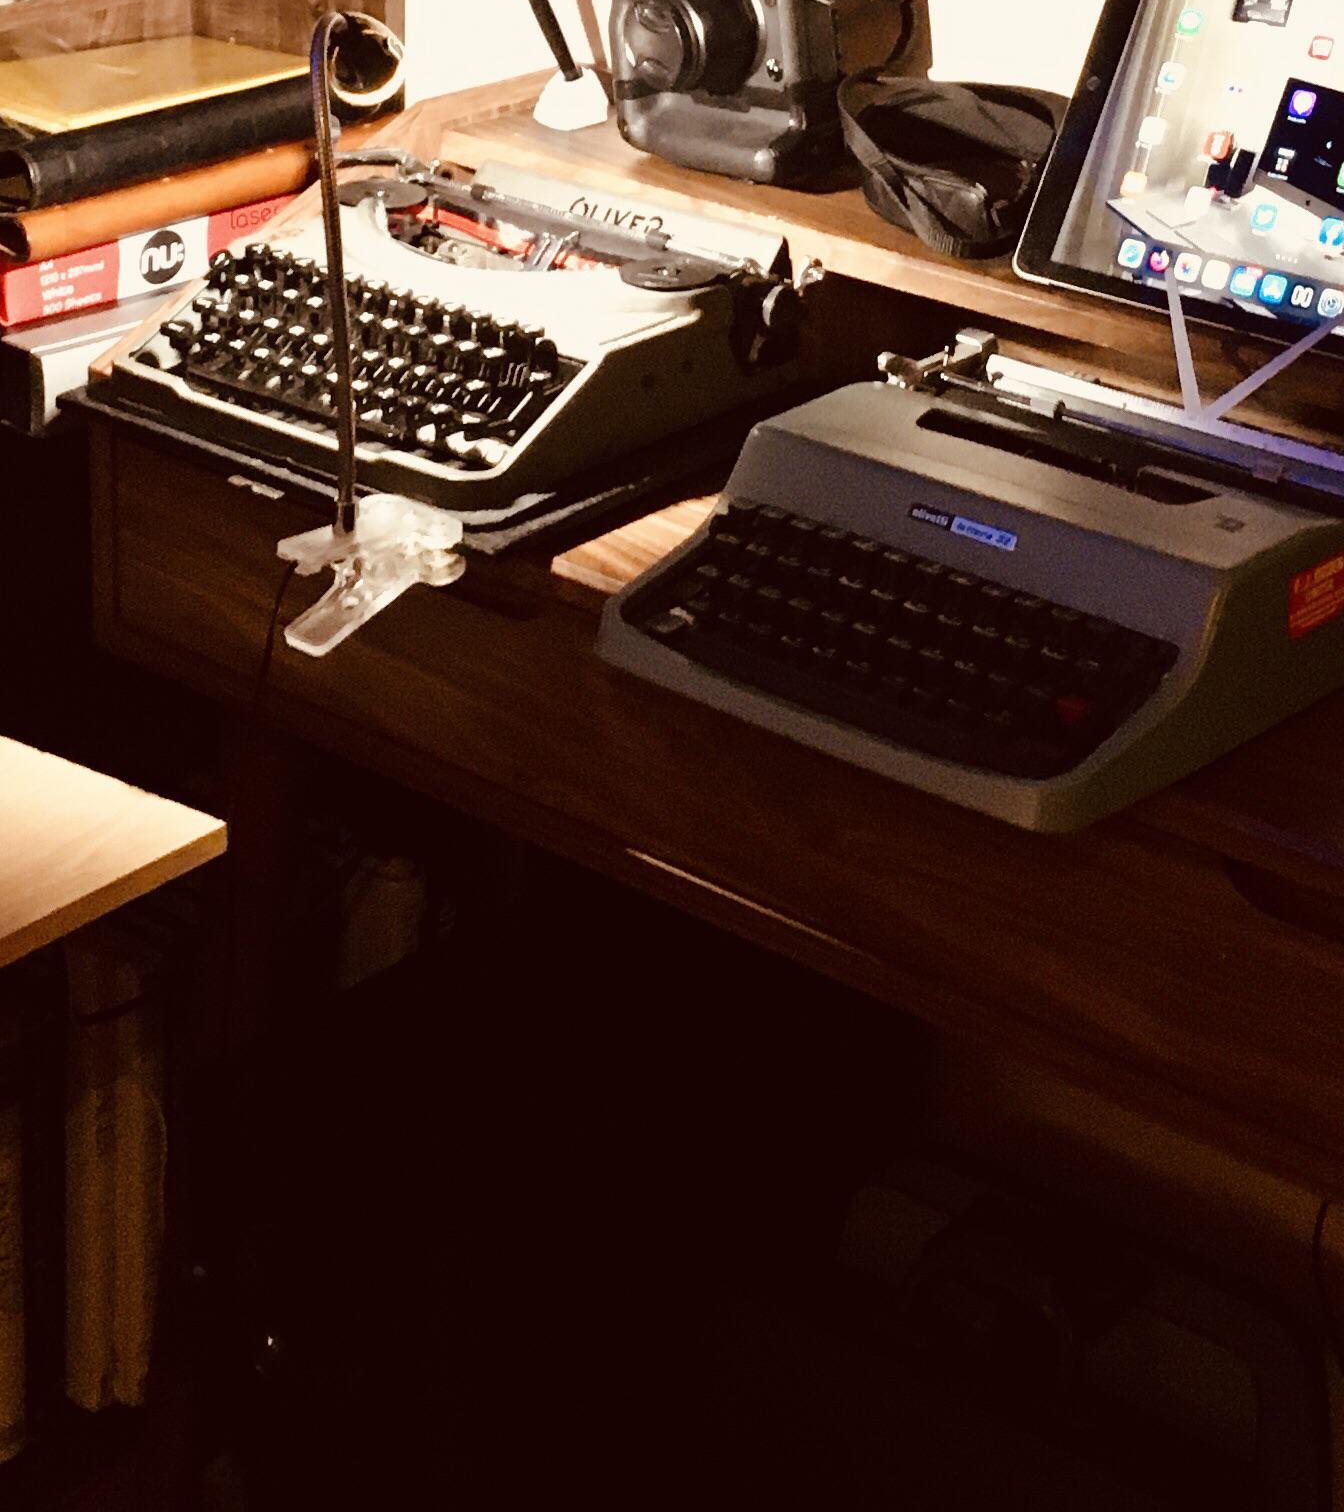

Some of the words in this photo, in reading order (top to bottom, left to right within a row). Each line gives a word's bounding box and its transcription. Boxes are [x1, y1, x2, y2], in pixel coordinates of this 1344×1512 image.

[42, 284, 75, 301] White
[64, 291, 103, 309] Sheets
[911, 507, 949, 527] olivetti
